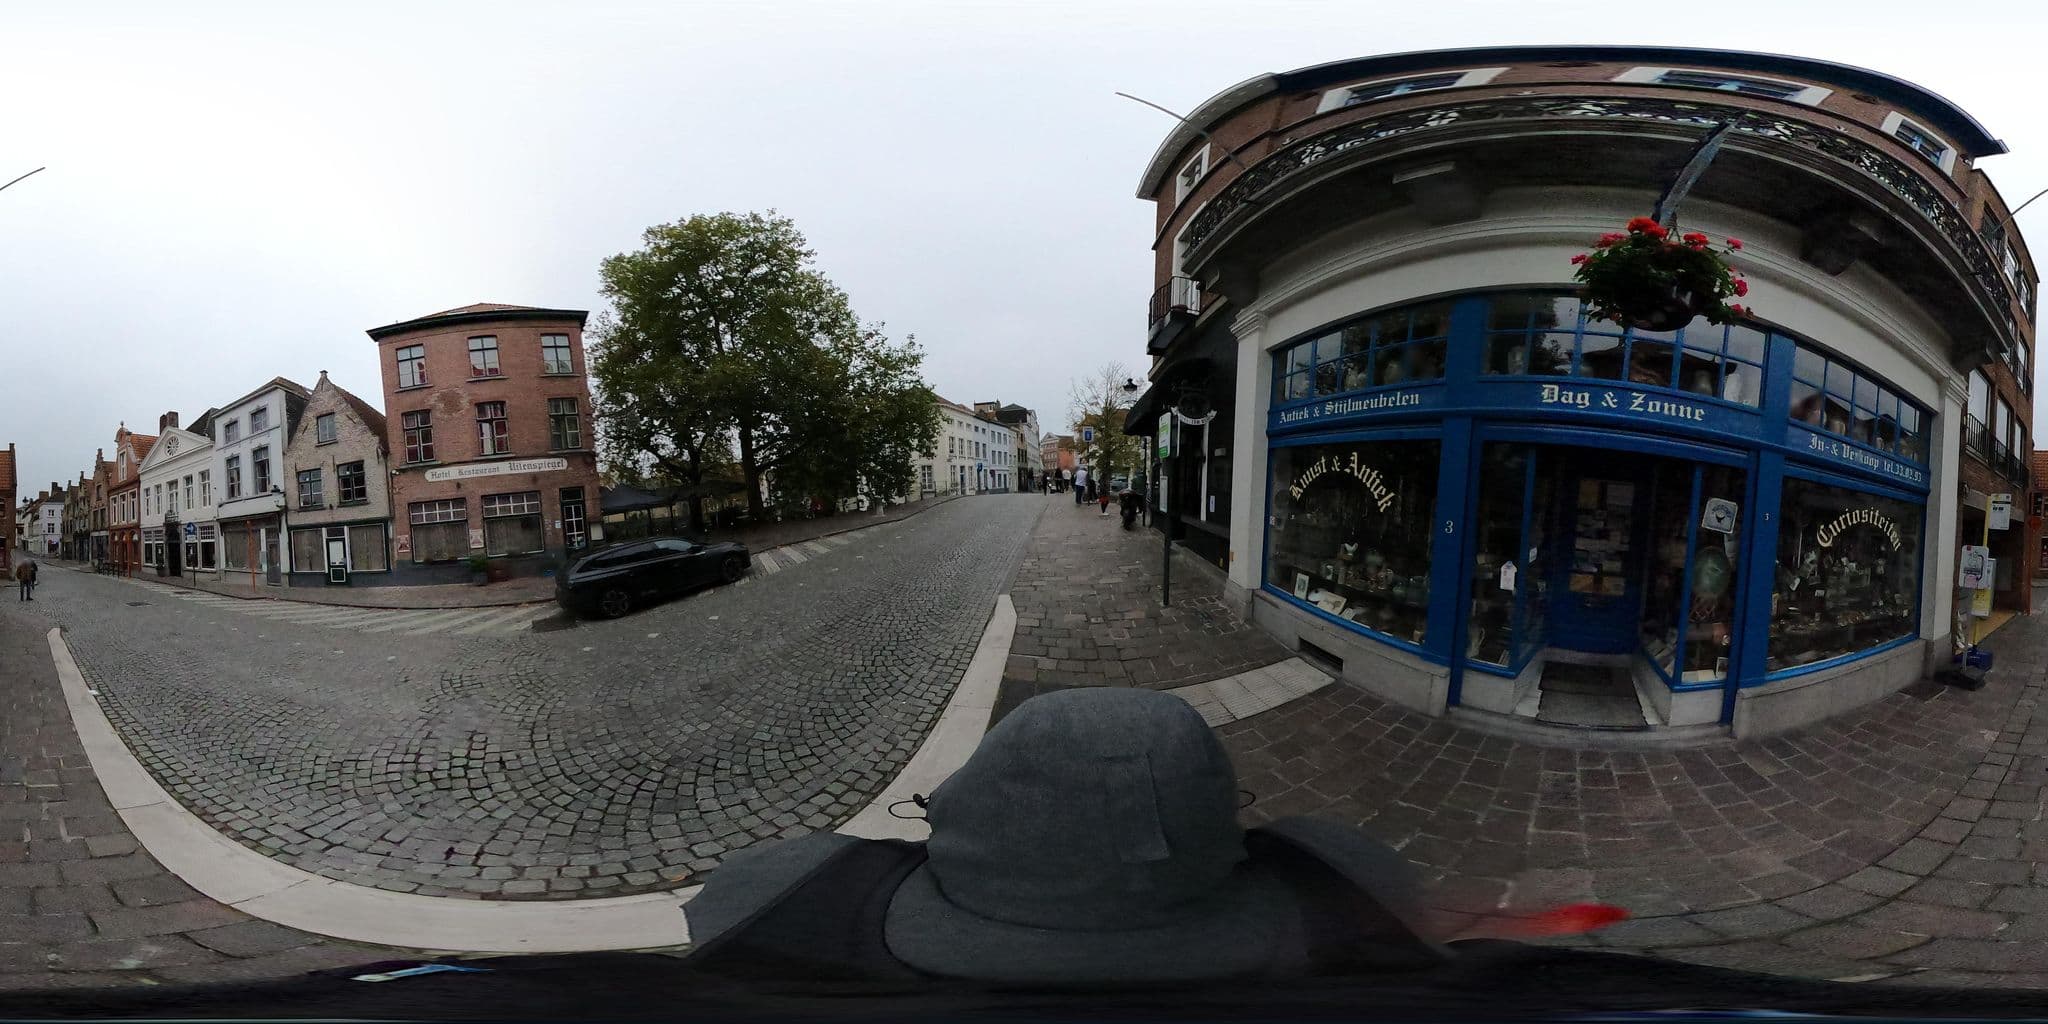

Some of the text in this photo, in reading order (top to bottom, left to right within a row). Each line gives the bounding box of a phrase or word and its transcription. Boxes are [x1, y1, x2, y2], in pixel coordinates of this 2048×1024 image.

[1279, 391, 1420, 424] Antiek & Stijlmeubelen
[1541, 384, 1705, 421] Dag & Zonne
[430, 469, 451, 480] Hotel
[1289, 451, 1396, 513] Kunst & Antiek
[1444, 520, 1454, 534] 3
[1816, 506, 1902, 552] Curiositeiten
